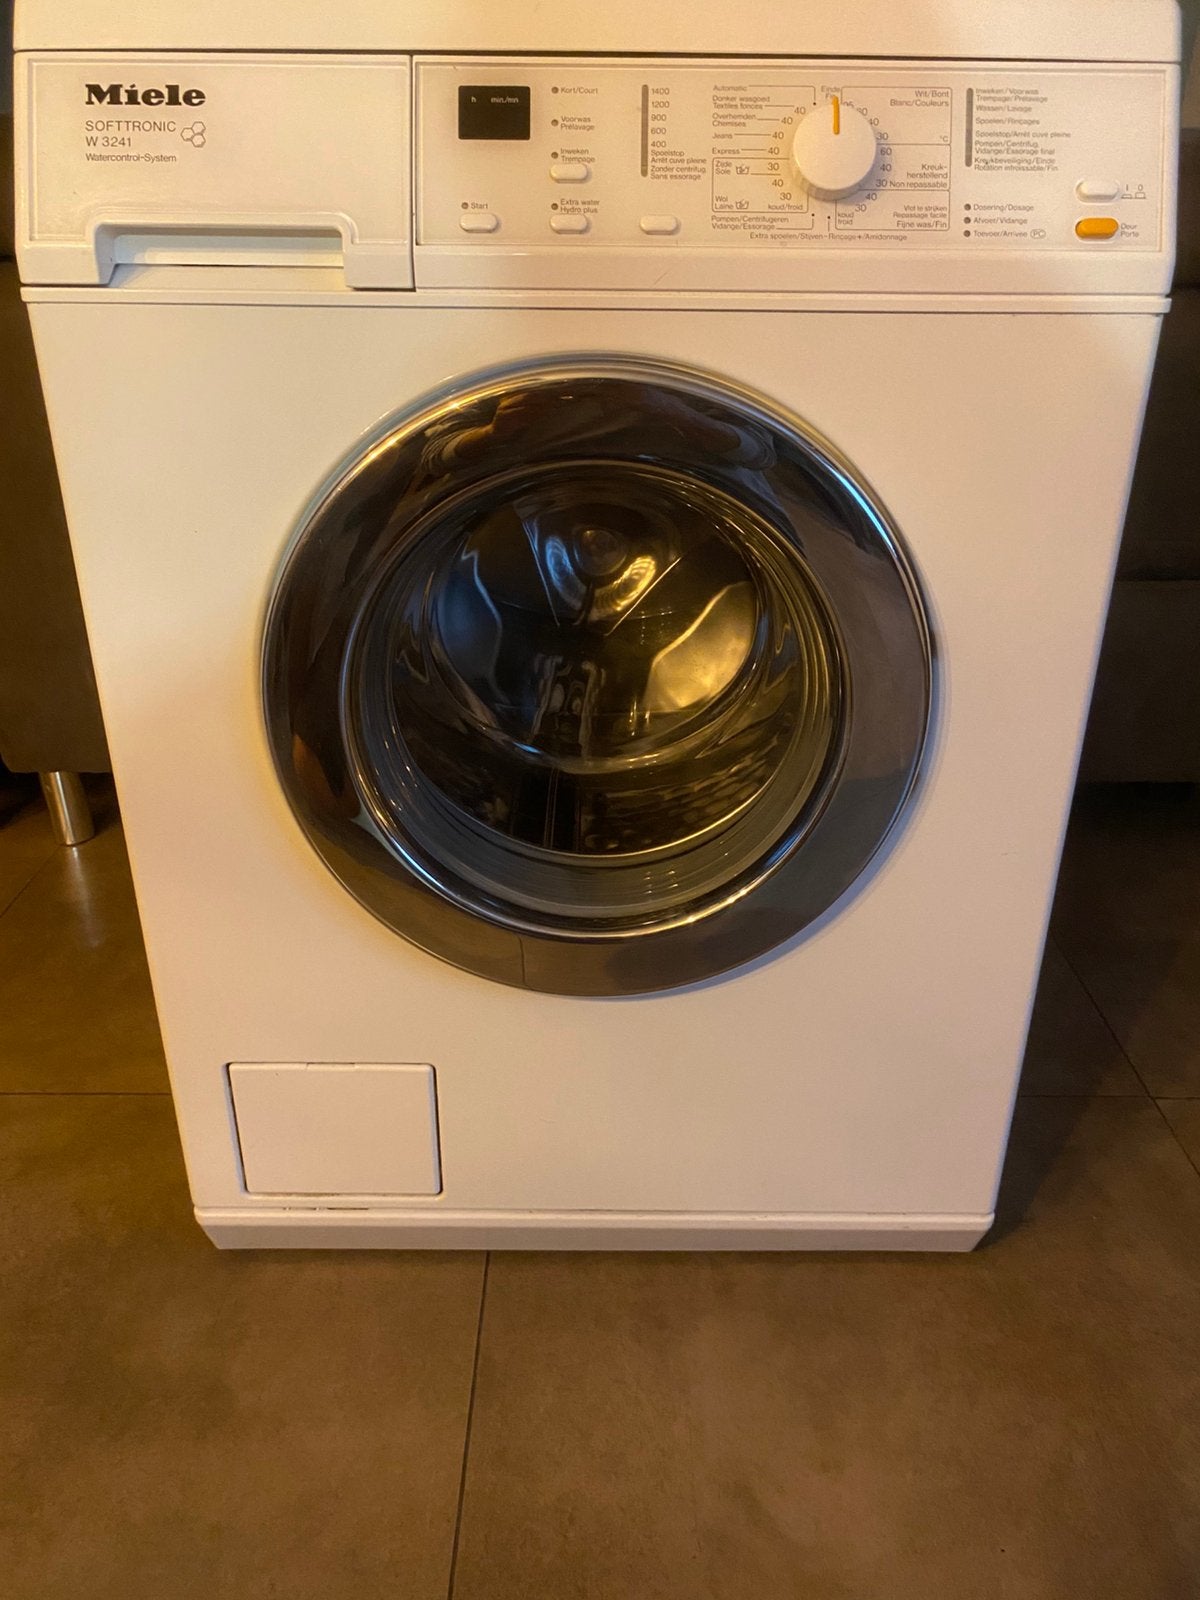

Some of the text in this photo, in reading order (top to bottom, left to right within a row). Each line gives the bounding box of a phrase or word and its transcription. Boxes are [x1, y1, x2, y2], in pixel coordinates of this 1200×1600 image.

[86, 84, 206, 106] Miele
[890, 99, 949, 107] Blanc/Couleurs
[794, 107, 806, 115] 40
[86, 120, 176, 132] SOFTTRONIC
[876, 132, 888, 140] 30
[86, 136, 132, 147] W 3241
[880, 147, 892, 156] 60
[86, 154, 176, 164] Watercontrol-System
[768, 162, 779, 171] 30
[880, 163, 891, 172] 40
[772, 179, 784, 187] 40
[876, 179, 887, 187] 30
[780, 192, 792, 201] 30
[865, 193, 877, 201] 40
[855, 204, 867, 212] 30
